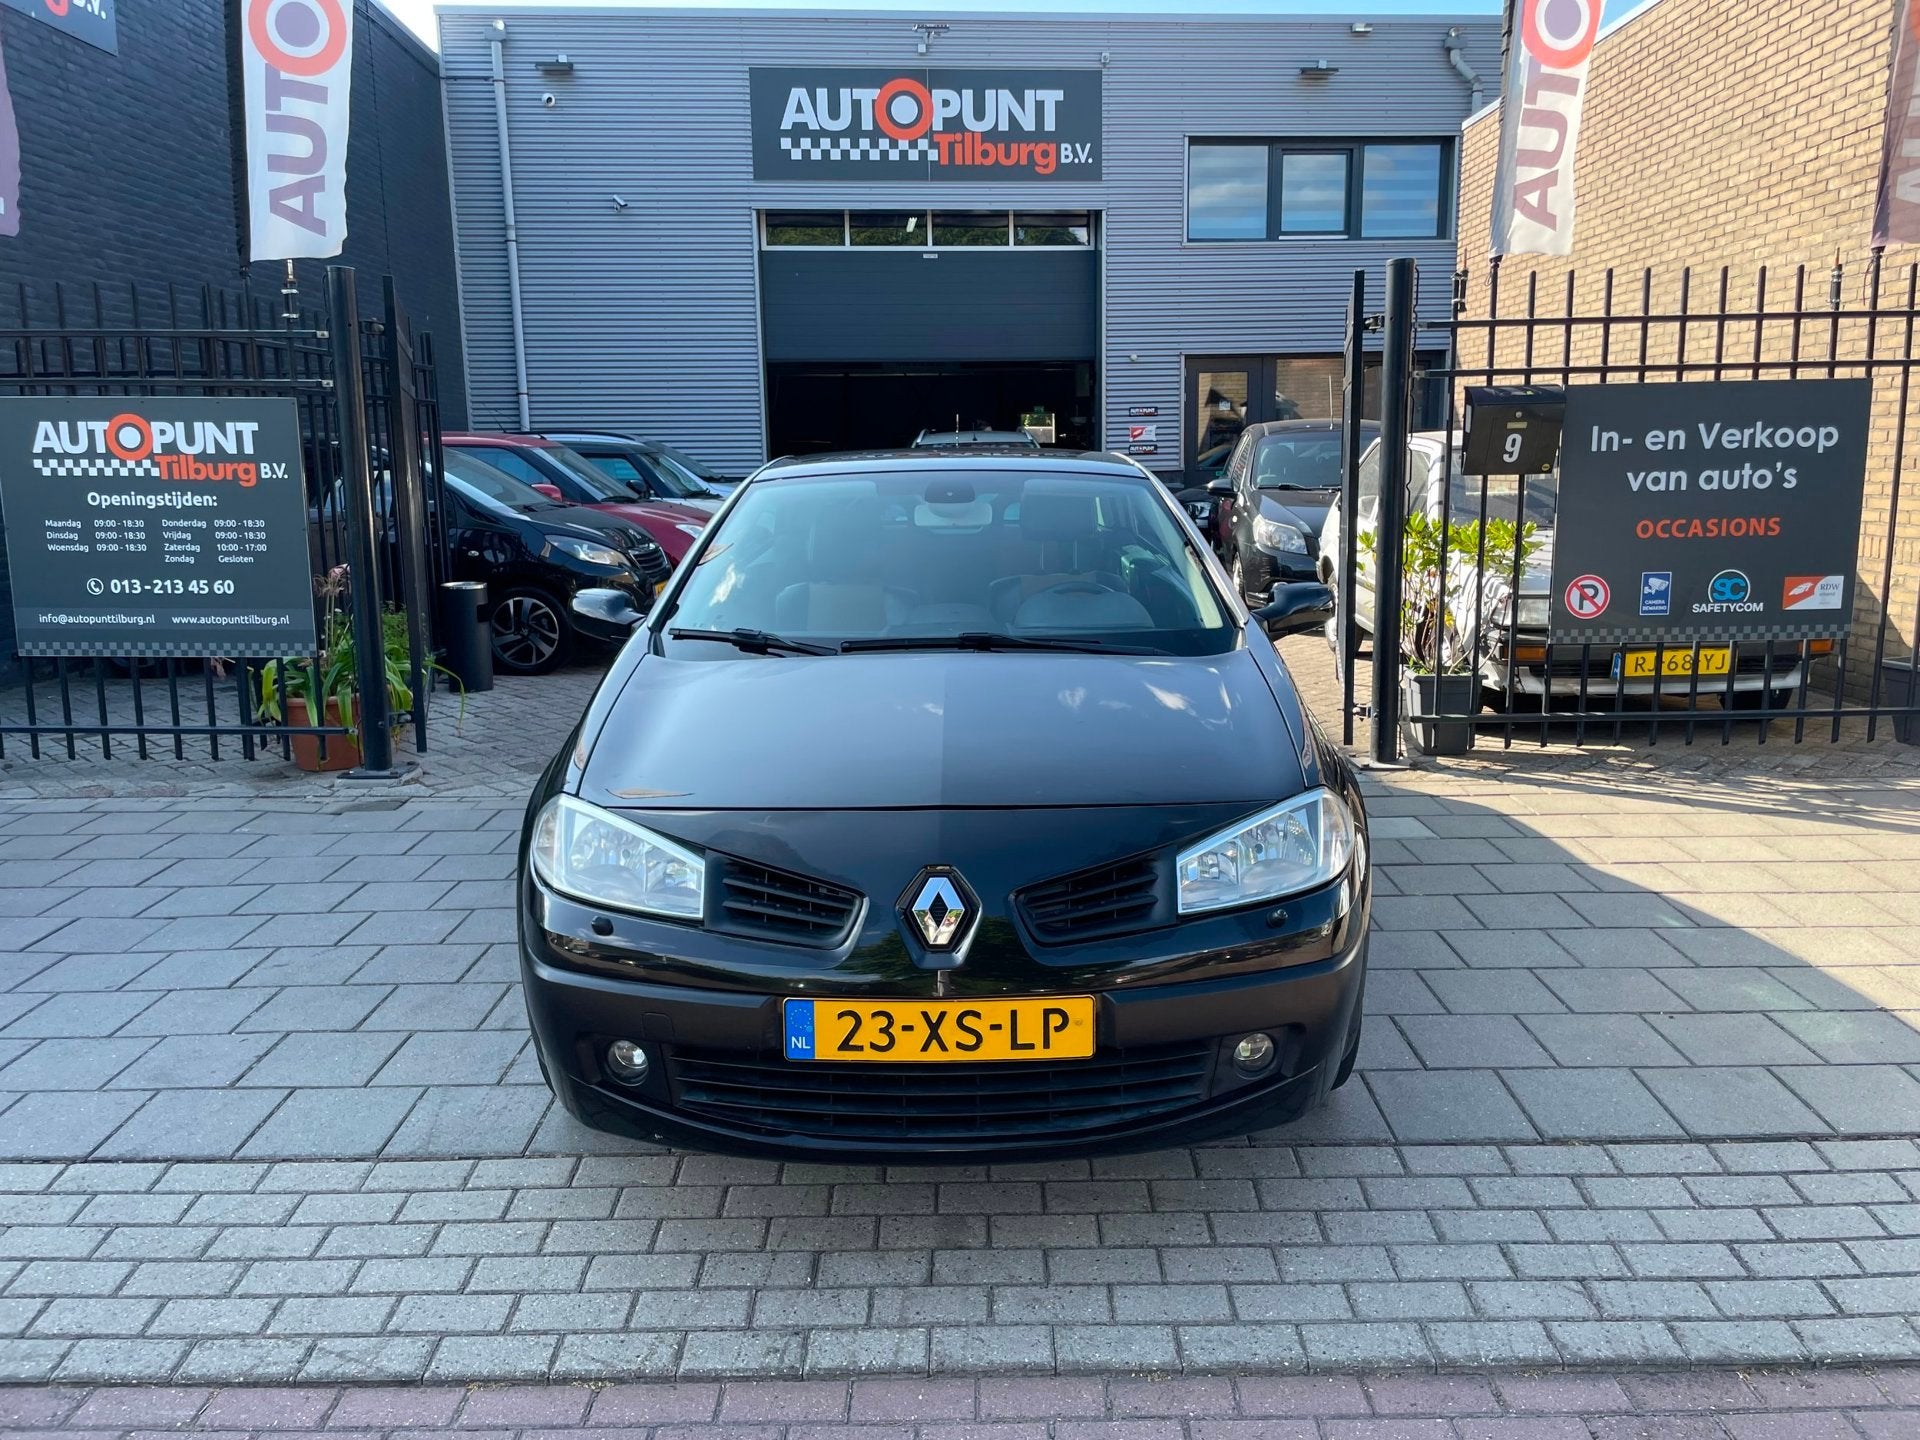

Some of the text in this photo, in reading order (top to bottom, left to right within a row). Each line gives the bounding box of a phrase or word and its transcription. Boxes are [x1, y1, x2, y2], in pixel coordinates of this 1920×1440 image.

[780, 78, 1064, 141] AUTOPUNT
[933, 131, 1093, 175] Tilburg B.V.
[33, 413, 259, 462] AUTOPUNT
[1590, 421, 1840, 454] In- en Verkoop
[1503, 433, 1522, 463] 9
[155, 455, 289, 488] Tilburg B.V.
[1626, 462, 1798, 492] van auto's
[87, 491, 219, 510] Openingstijden:
[45, 519, 82, 529] Maandag
[94, 519, 117, 528] 09:00
[122, 519, 145, 528] 18:30
[161, 519, 207, 529] Donderdag
[214, 519, 237, 528] 09:00
[243, 519, 266, 528] 18:30
[1635, 517, 1782, 540] OCCASIONS
[46, 531, 79, 541] Dinsdag
[95, 531, 118, 540] 09:00
[124, 531, 146, 540] 18:30
[162, 531, 192, 541] Vrijdag
[215, 531, 238, 540] 09:00
[244, 531, 267, 540] 18:30
[47, 543, 90, 553] Woensdag
[96, 543, 119, 552] 09:00
[125, 543, 147, 552] 18:30
[163, 543, 201, 553] Zaterdag
[217, 543, 239, 552] 10:00
[245, 543, 267, 552] 17:00
[164, 554, 255, 565] Zondag Gesloten
[189, 579, 209, 595] 45
[214, 579, 235, 595] 60
[1820, 583, 1841, 591] RDW
[1692, 602, 1764, 613] SAFETYCOM
[38, 613, 290, 626] info@autopunttilburg.nl www.autopunttilburg.nl
[836, 1008, 1070, 1053] 23-XS-LP
[791, 1036, 811, 1049] NL
